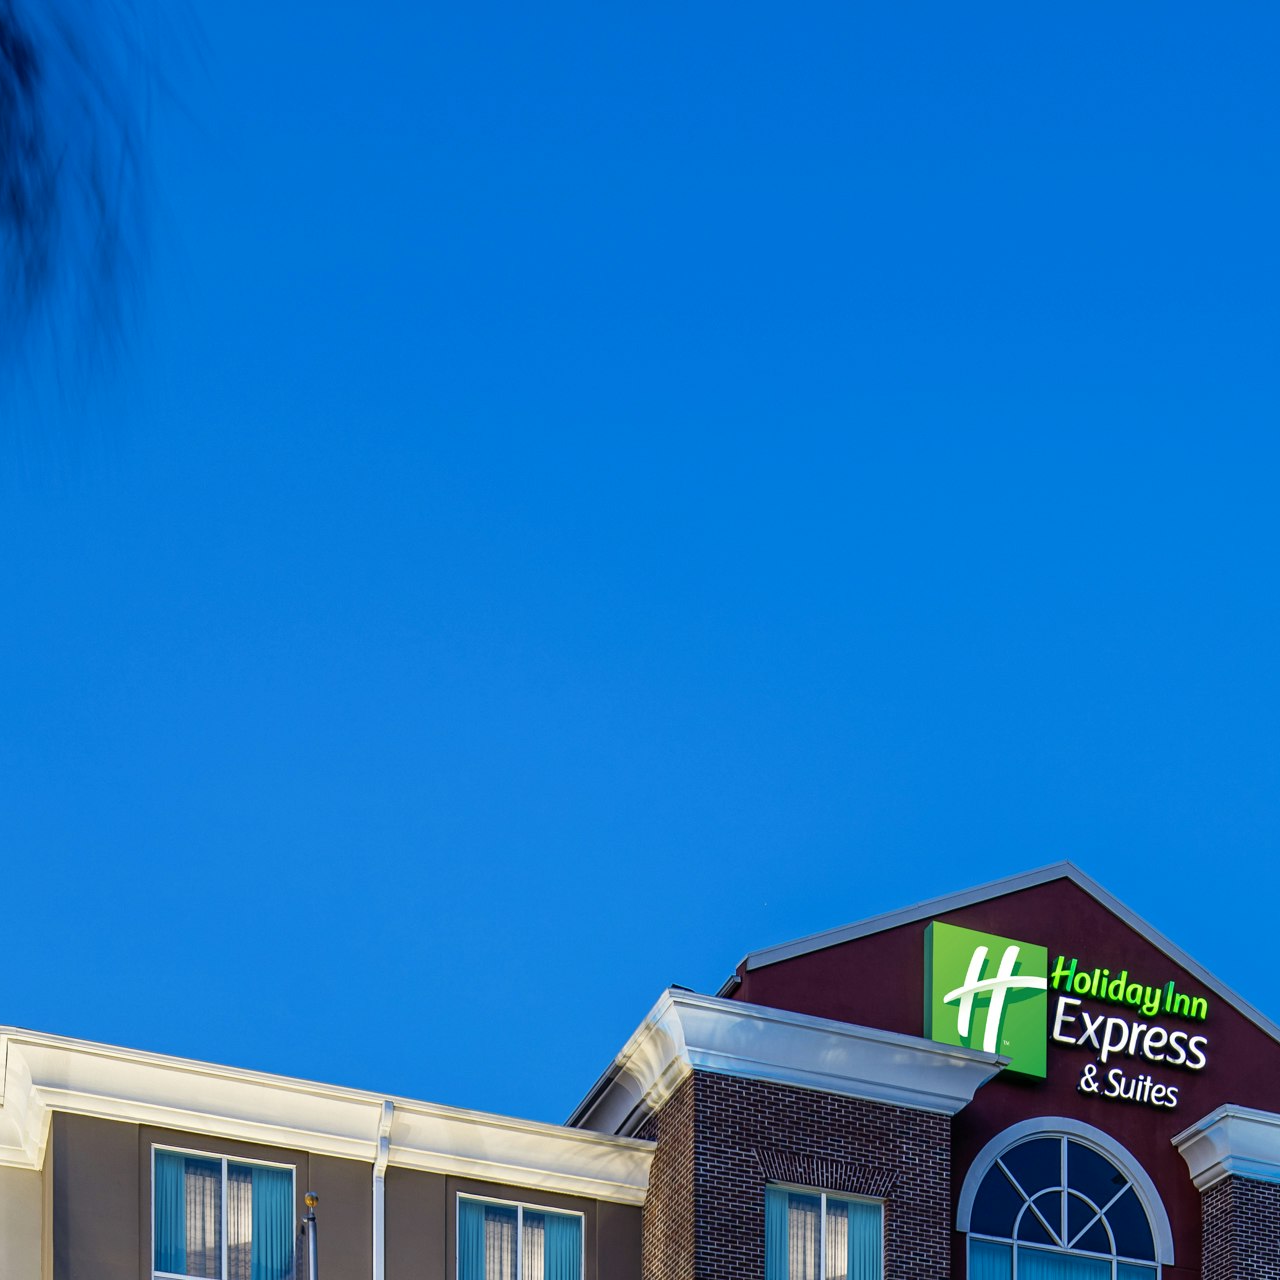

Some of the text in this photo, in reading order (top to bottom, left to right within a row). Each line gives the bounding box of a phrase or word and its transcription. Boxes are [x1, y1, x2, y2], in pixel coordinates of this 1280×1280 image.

[1051, 955, 1208, 1020] Holiday Inn
[1052, 996, 1208, 1069] Express
[1080, 1063, 1179, 1108] & Suites
